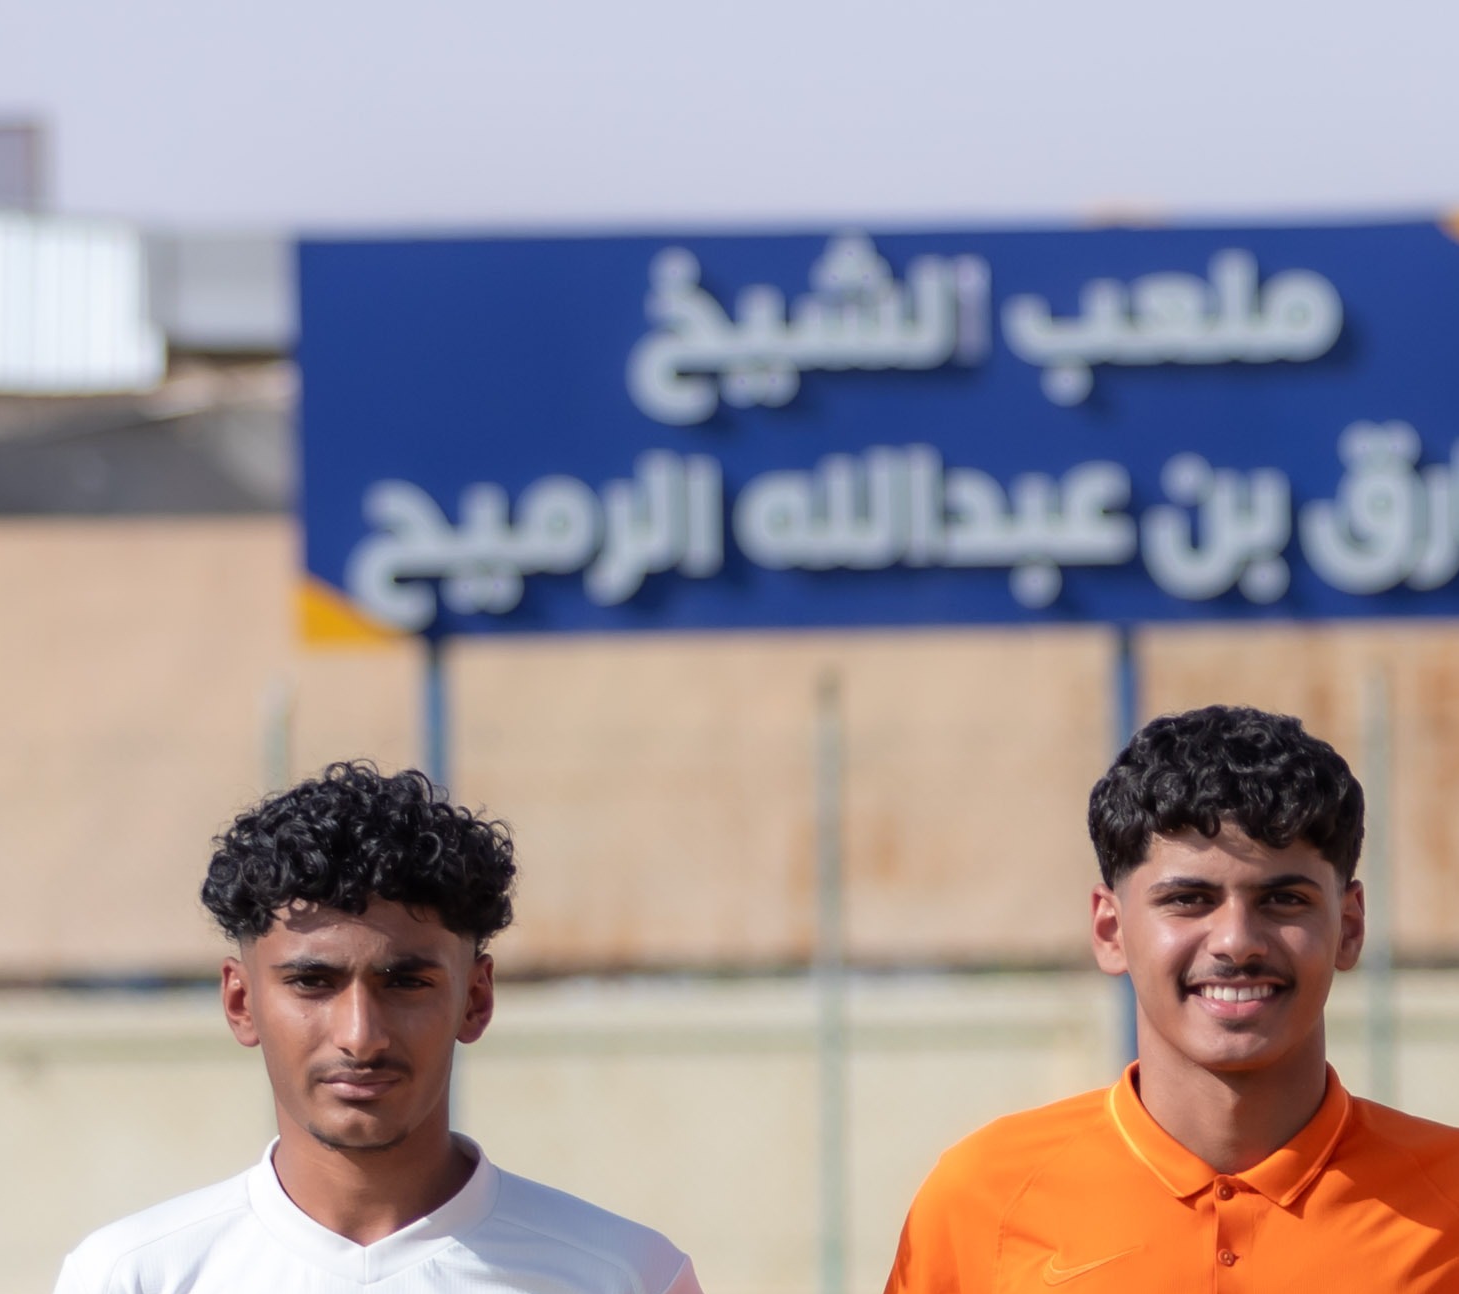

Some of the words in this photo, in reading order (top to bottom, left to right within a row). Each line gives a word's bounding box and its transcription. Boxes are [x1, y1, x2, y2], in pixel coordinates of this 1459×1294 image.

[629, 230, 990, 422] الشيخ
[1004, 250, 1342, 402] ملعب
[344, 452, 720, 630] الرميح
[737, 447, 1135, 602] عبدالله
[1143, 457, 1289, 597] بن
